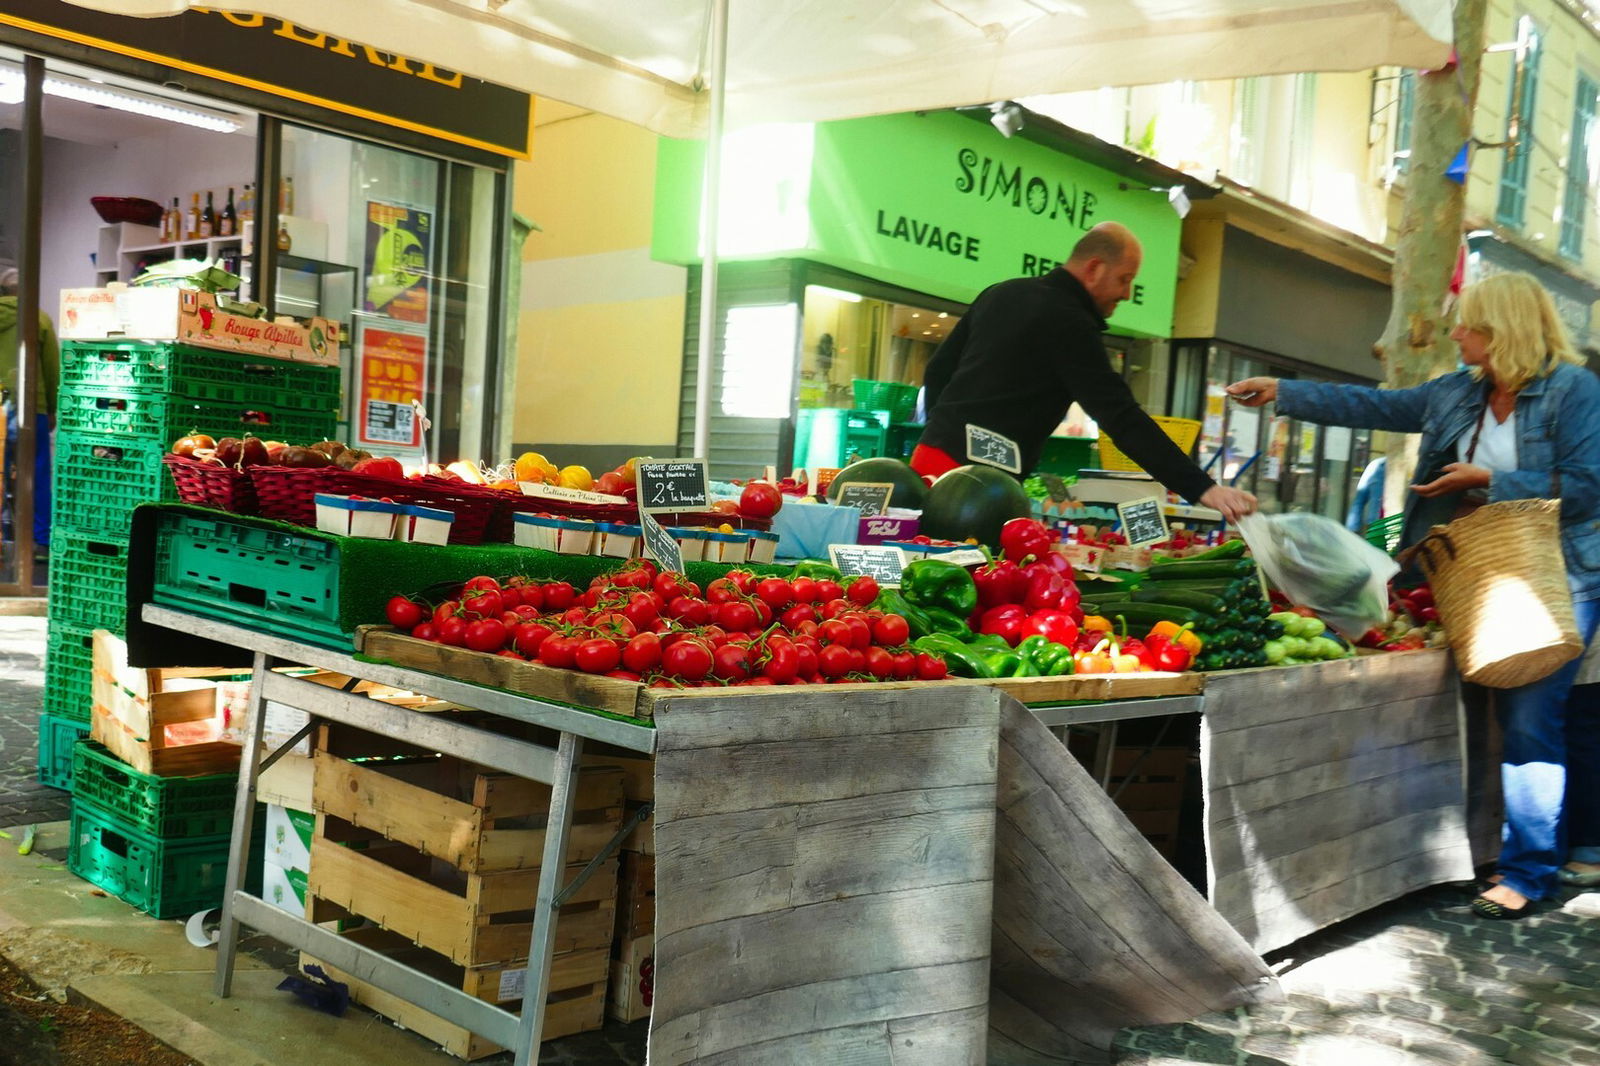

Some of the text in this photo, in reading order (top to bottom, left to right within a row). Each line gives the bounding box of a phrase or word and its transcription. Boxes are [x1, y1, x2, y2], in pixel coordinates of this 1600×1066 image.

[955, 148, 1098, 231] SIMONE
[876, 209, 980, 261] LAVAGE
[225, 317, 304, 347] Rouge Alpilles
